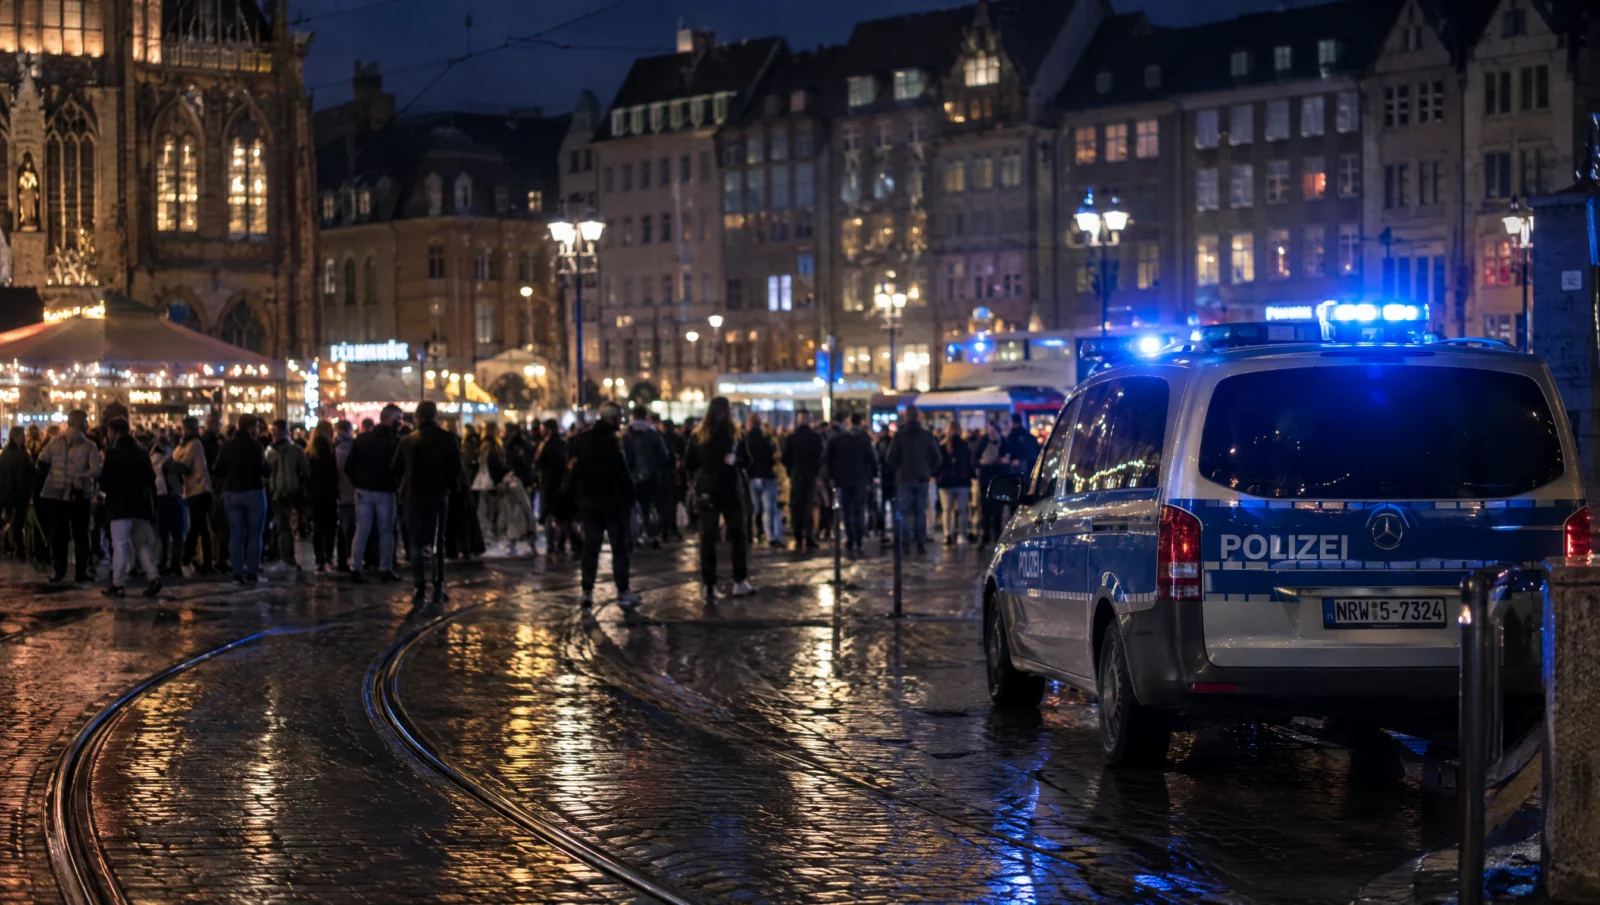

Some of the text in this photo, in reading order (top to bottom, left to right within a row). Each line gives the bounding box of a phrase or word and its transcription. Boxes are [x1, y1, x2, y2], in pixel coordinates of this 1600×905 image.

[1220, 533, 1349, 560] POLIZEI
[1018, 551, 1040, 578] POLIZEI
[1336, 601, 1442, 621] NRW 5-7324
